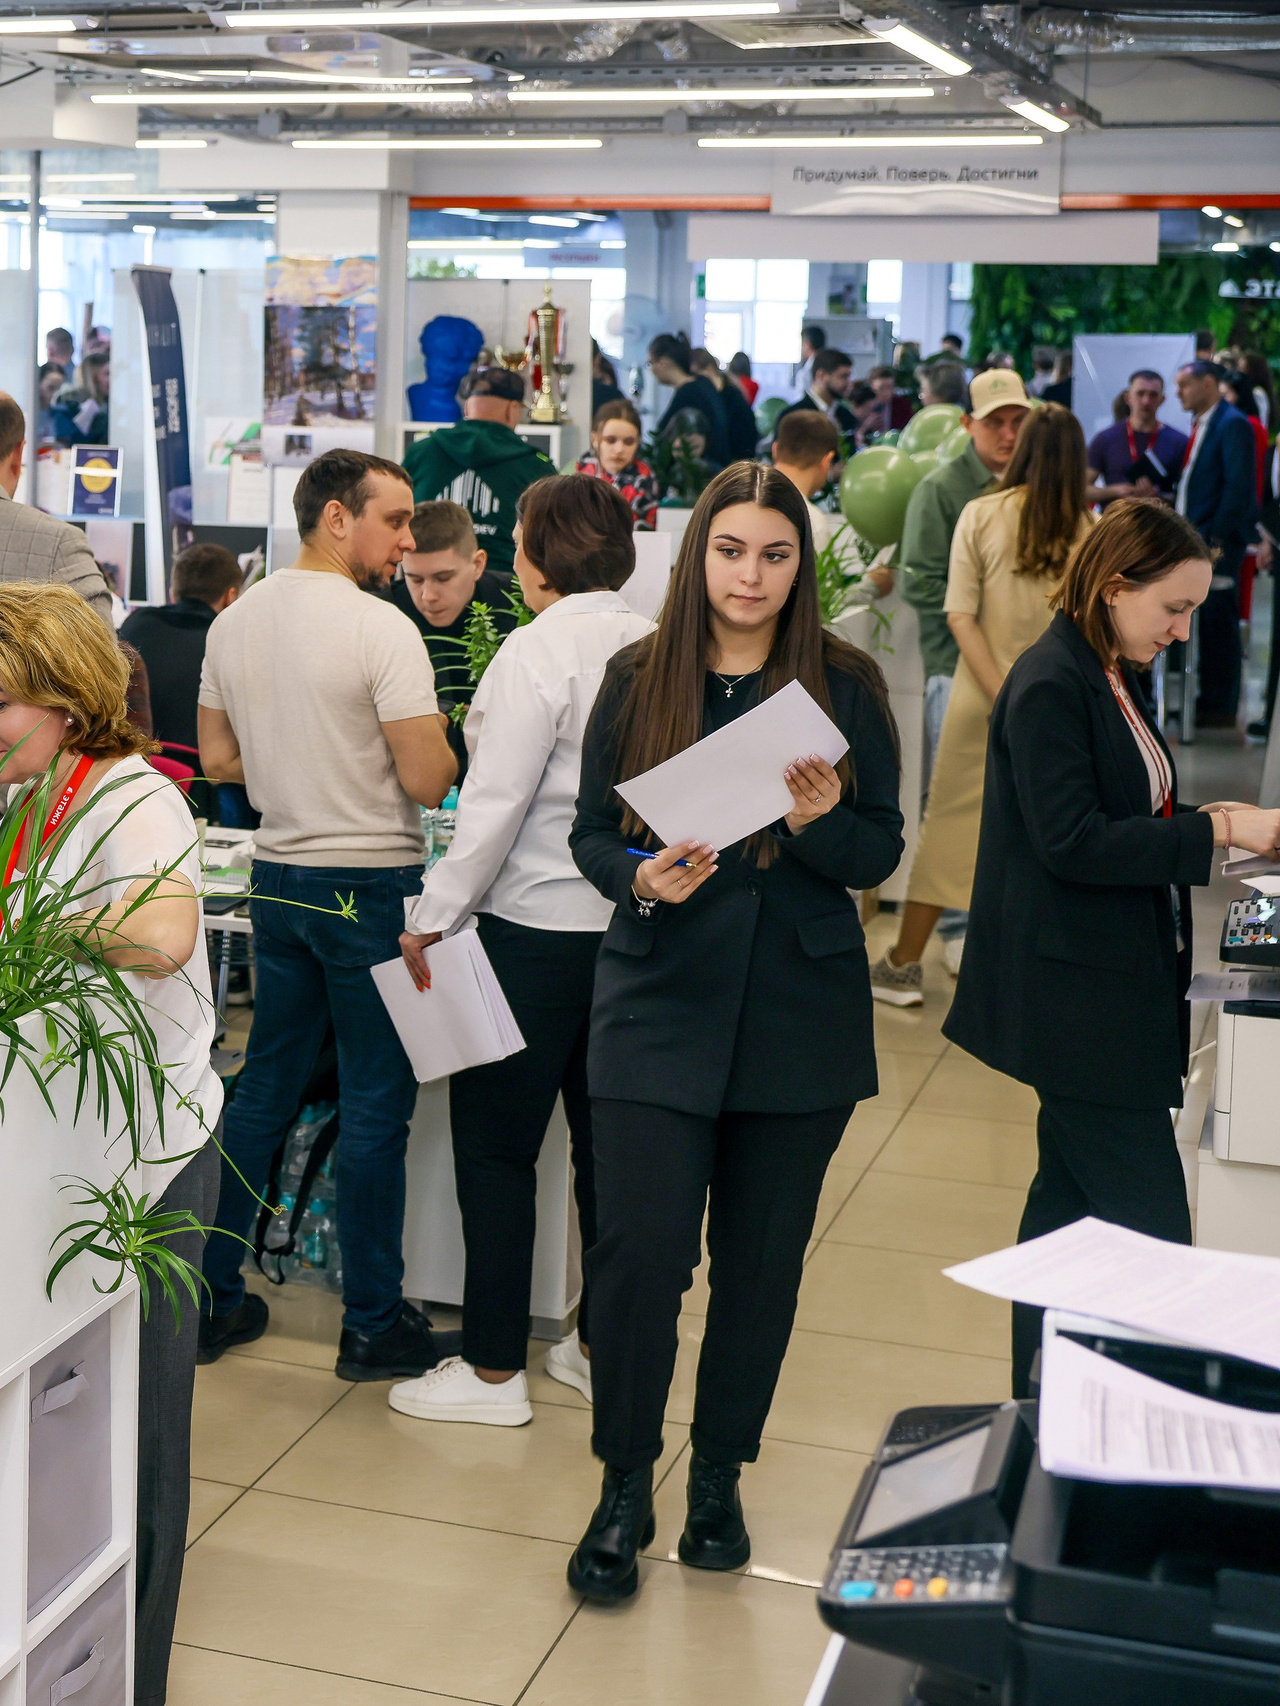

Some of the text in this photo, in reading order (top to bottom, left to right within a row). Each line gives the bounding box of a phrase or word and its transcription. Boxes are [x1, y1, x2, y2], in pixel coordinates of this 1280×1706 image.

[793, 165, 1039, 183] Придумай. Поверь. Достигни
